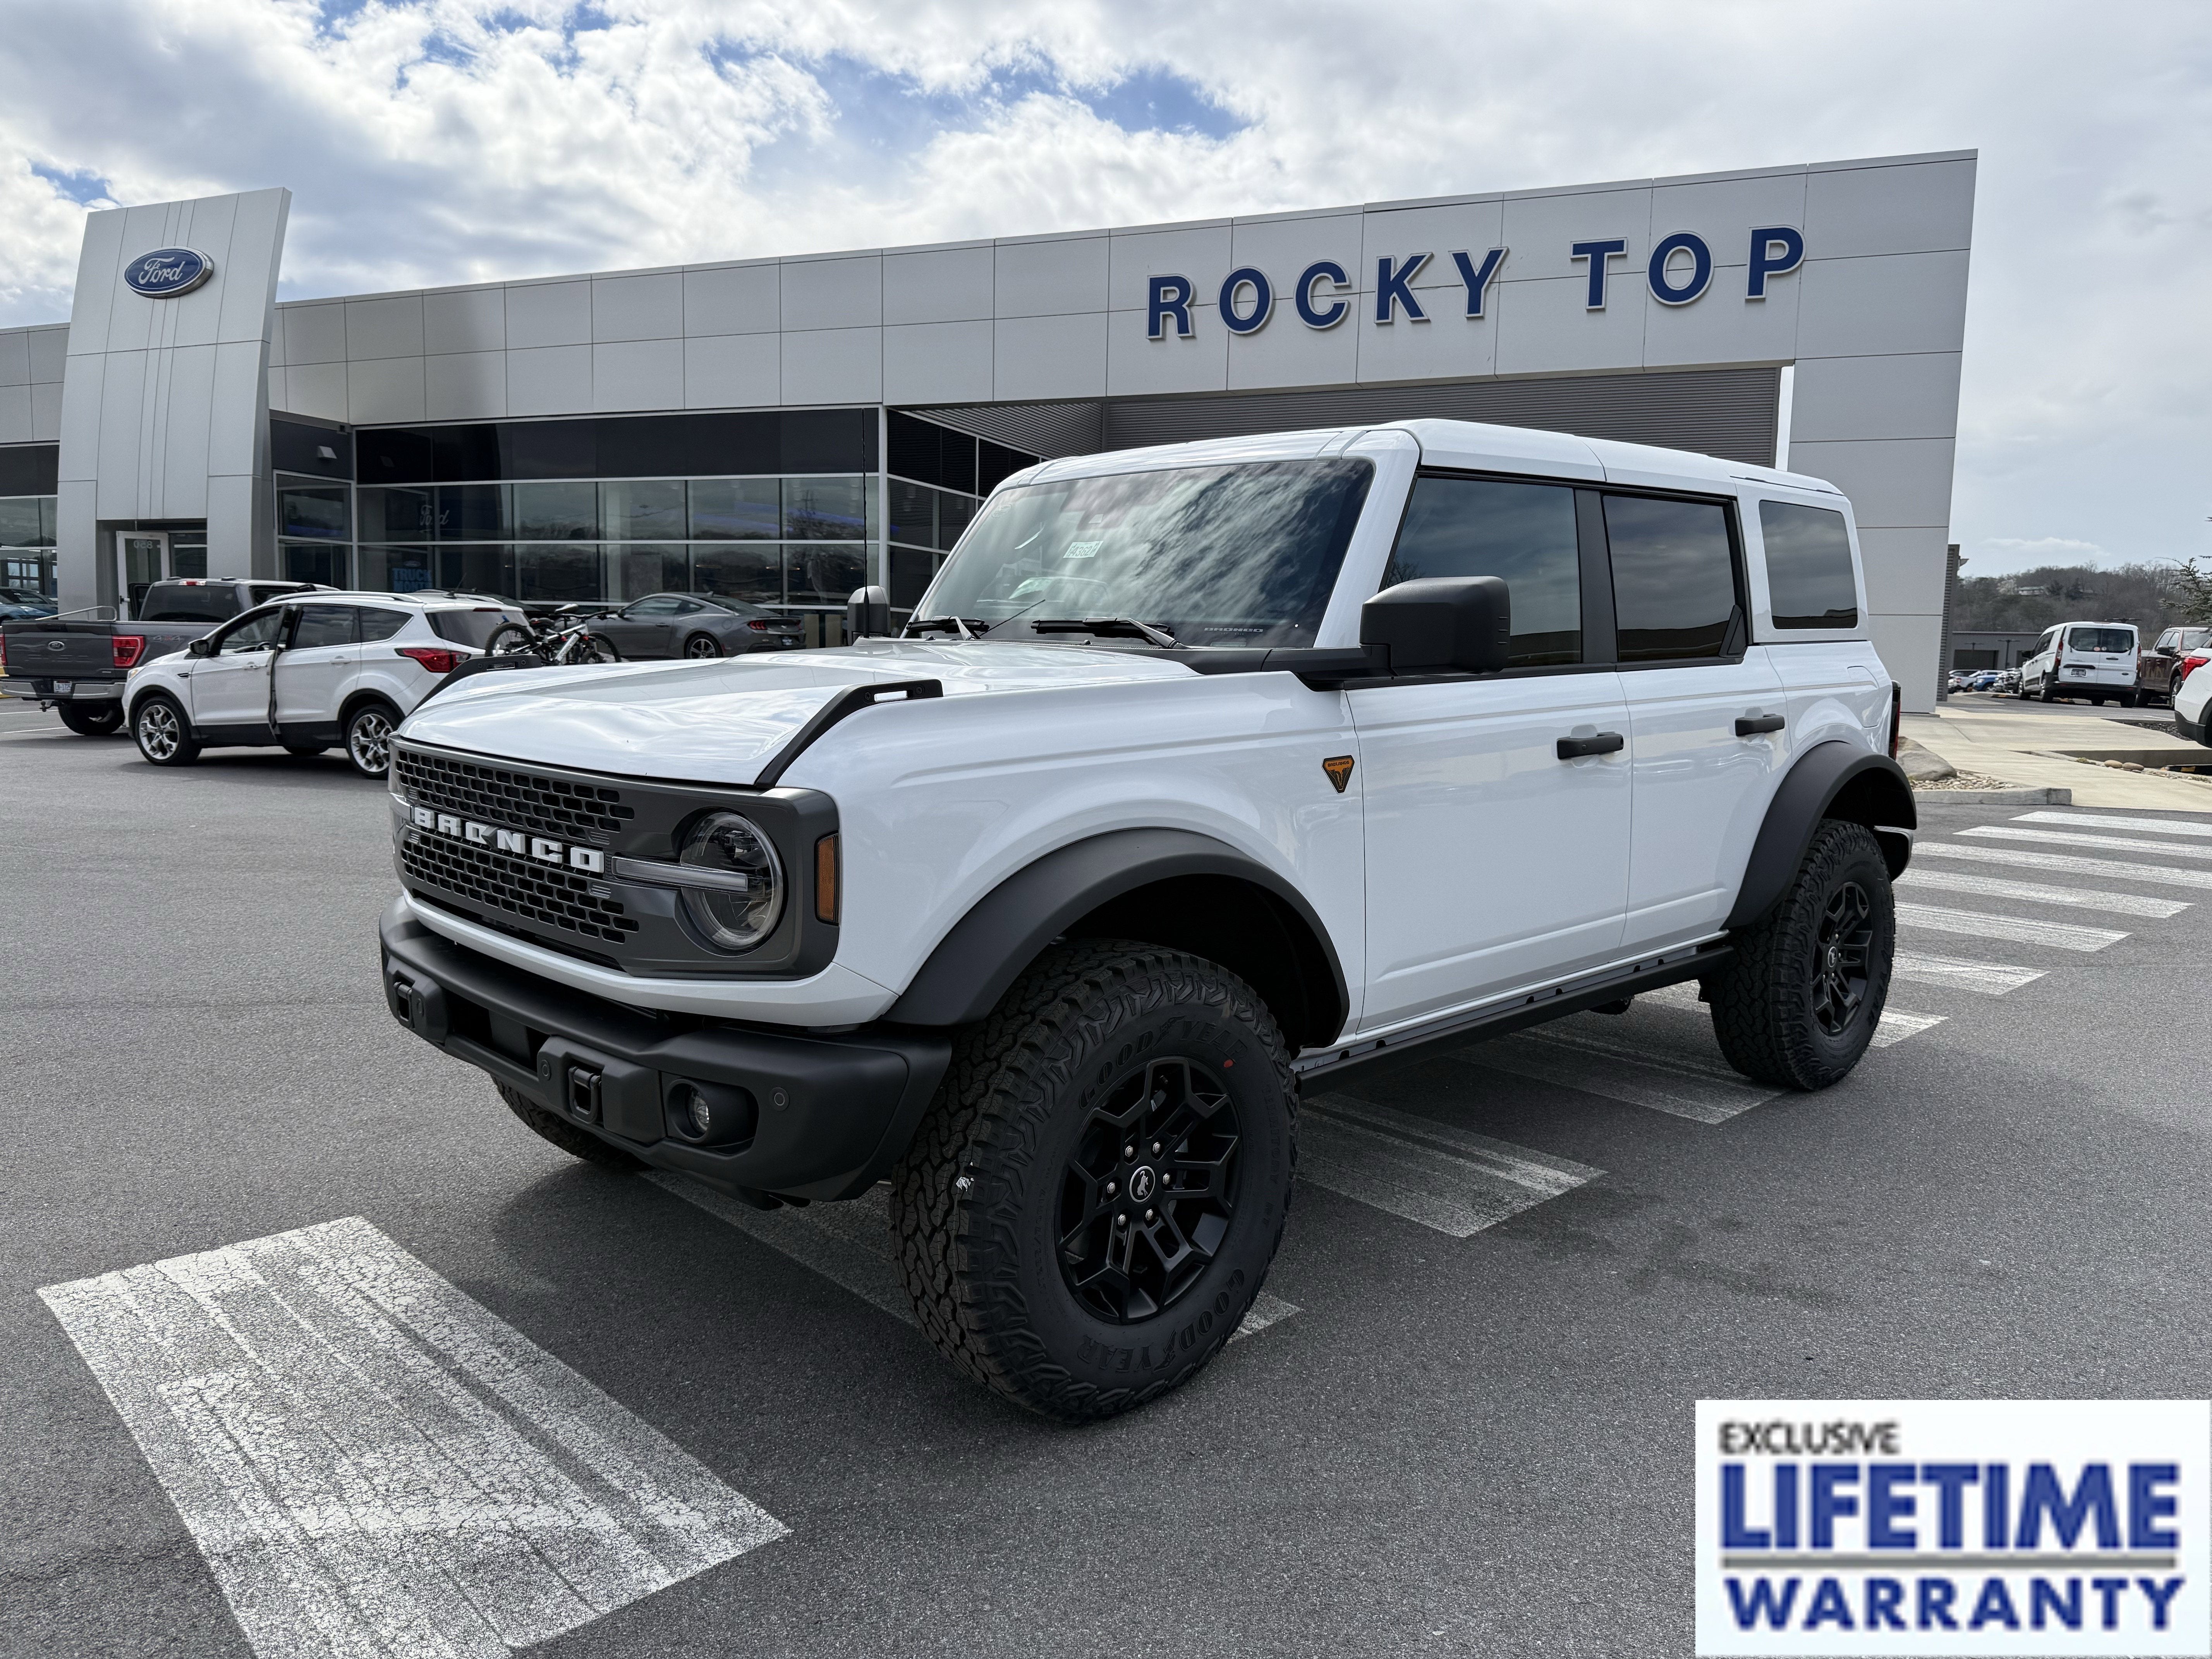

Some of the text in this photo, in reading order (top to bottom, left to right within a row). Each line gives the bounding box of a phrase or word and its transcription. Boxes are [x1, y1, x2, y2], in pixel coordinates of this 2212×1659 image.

[138, 257, 185, 284] Ford
[1146, 225, 1806, 340] ROCKY TOP
[420, 505, 450, 526] Fod
[414, 806, 605, 874] BRONCO
